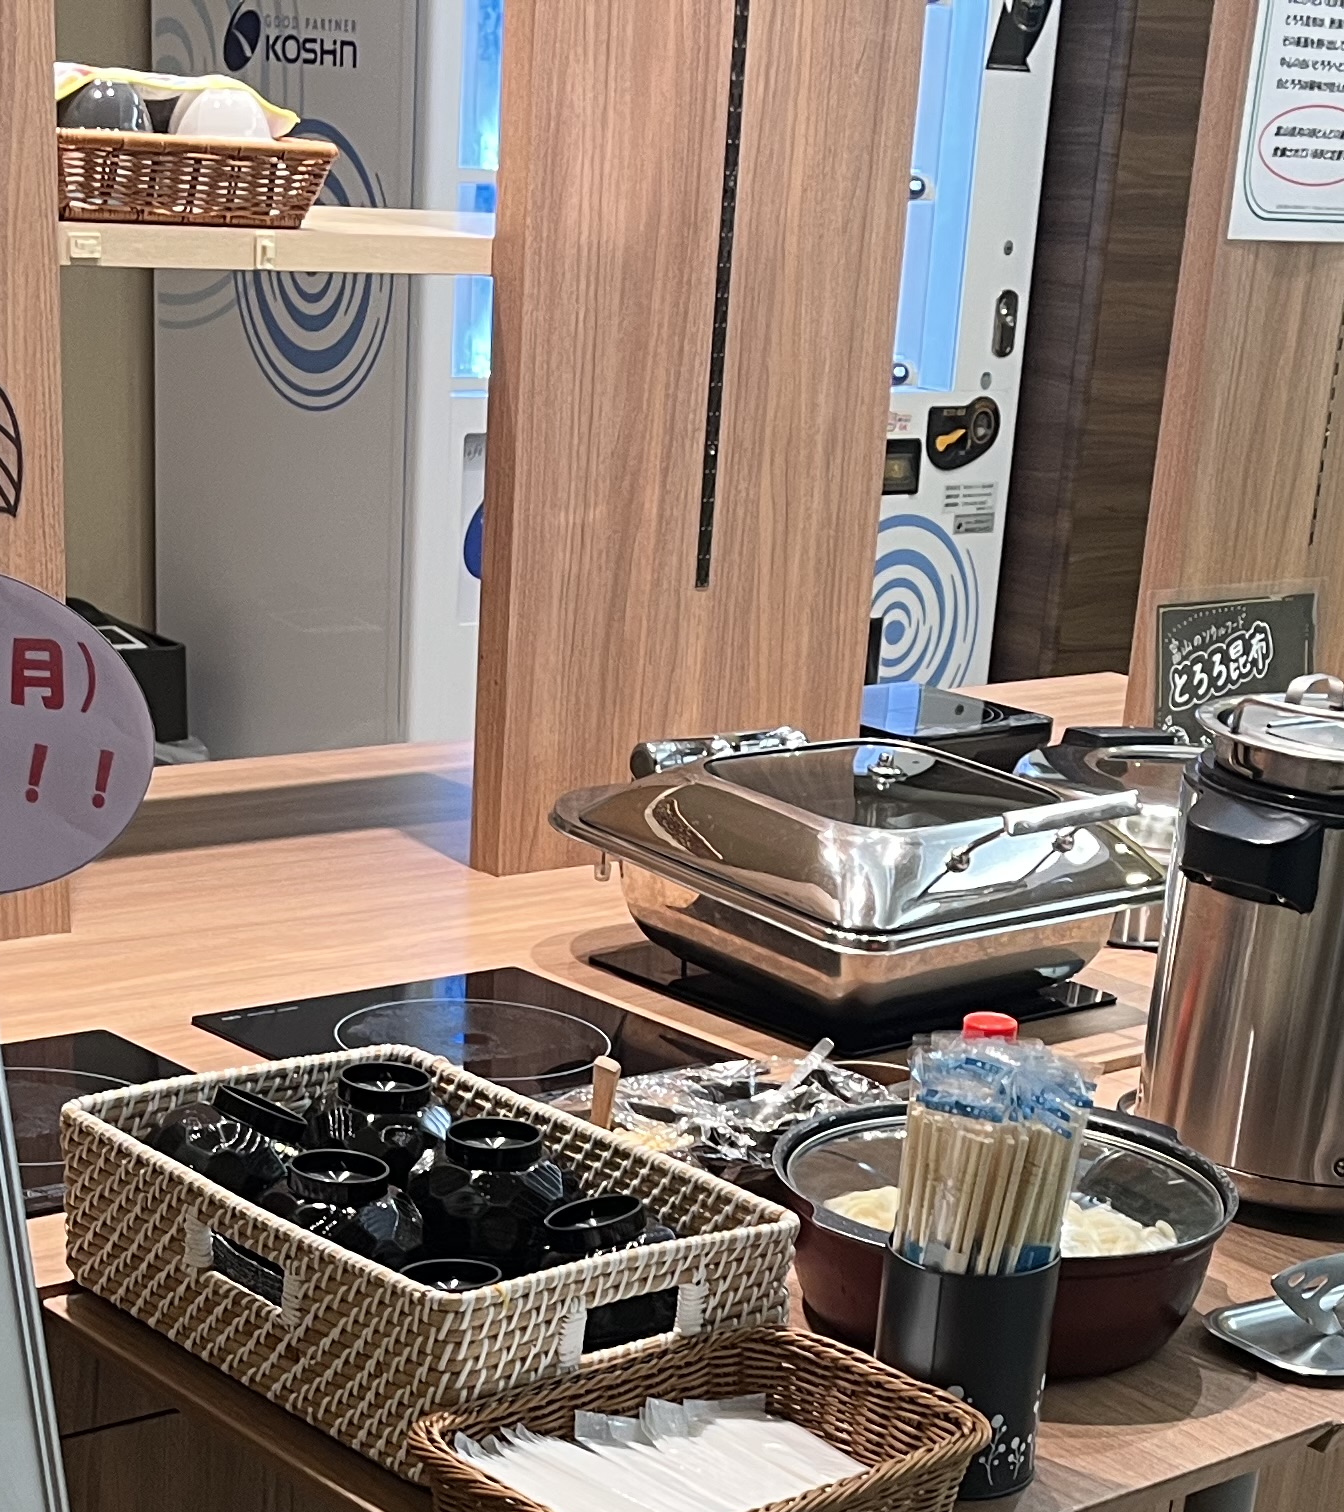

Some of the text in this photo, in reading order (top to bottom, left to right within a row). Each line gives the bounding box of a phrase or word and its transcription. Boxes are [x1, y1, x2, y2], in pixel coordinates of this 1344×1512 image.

[1174, 632, 1267, 704] とろろ昆布
